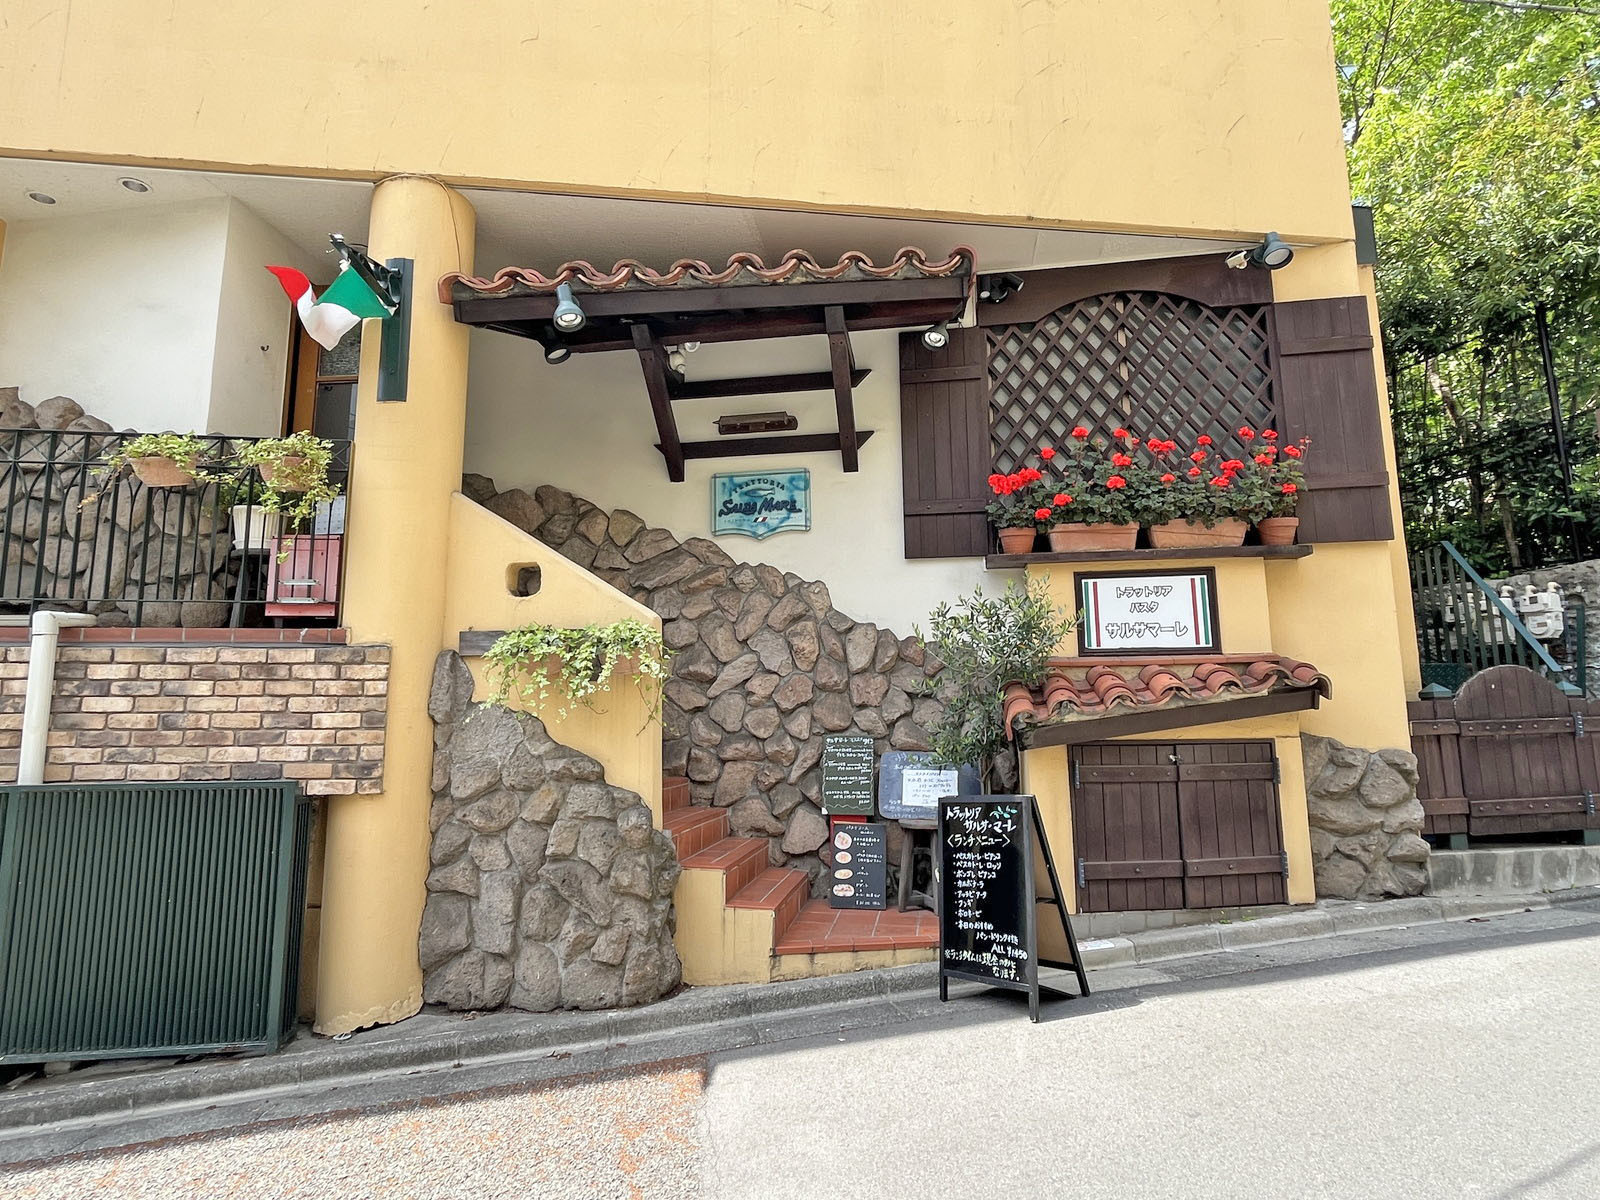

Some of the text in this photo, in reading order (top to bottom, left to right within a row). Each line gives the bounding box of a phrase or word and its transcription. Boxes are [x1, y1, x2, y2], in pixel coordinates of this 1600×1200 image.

[733, 478, 785, 493] TRATTORIA
[1116, 586, 1173, 598] トラットリア
[1130, 601, 1159, 613] パスタ
[1105, 621, 1188, 639] サルサマーレ
[946, 806, 982, 821] トラットリア
[990, 943, 1006, 954] ALL
